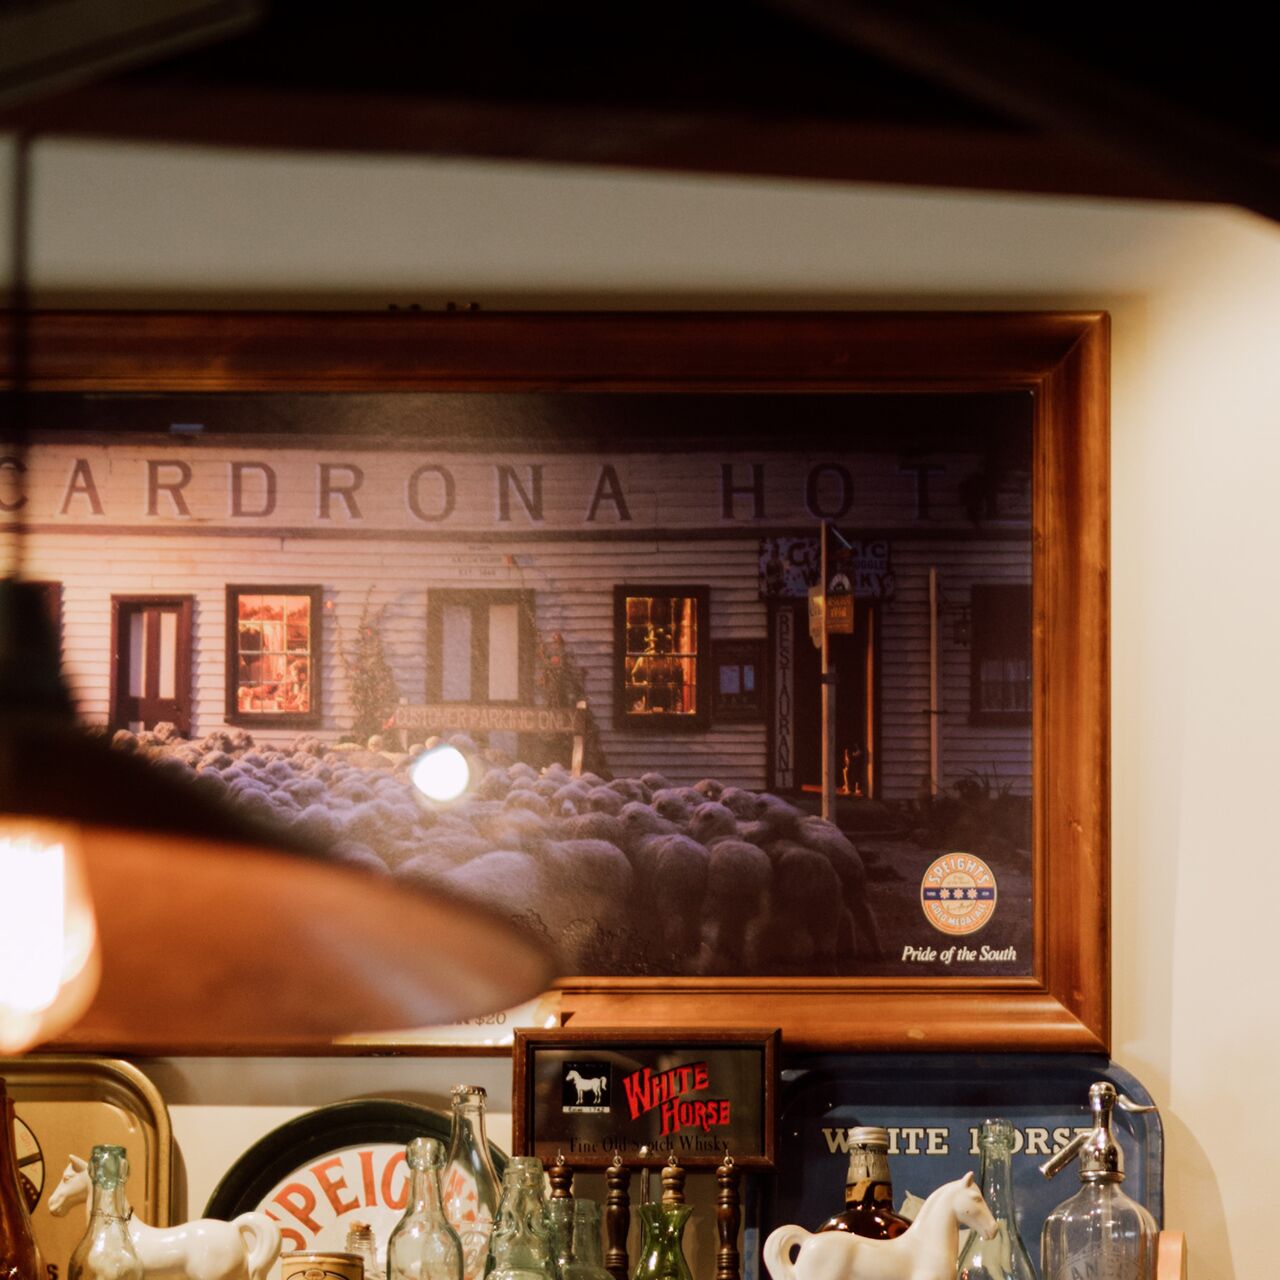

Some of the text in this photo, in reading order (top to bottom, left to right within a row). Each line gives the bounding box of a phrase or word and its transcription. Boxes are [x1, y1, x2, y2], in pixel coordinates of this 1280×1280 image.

[902, 945, 1017, 965] Pride of the South
[622, 1060, 710, 1121] WHITE
[659, 1097, 732, 1137] HORSE
[679, 1134, 729, 1152] Whisky
[821, 1127, 949, 1155] WITE
